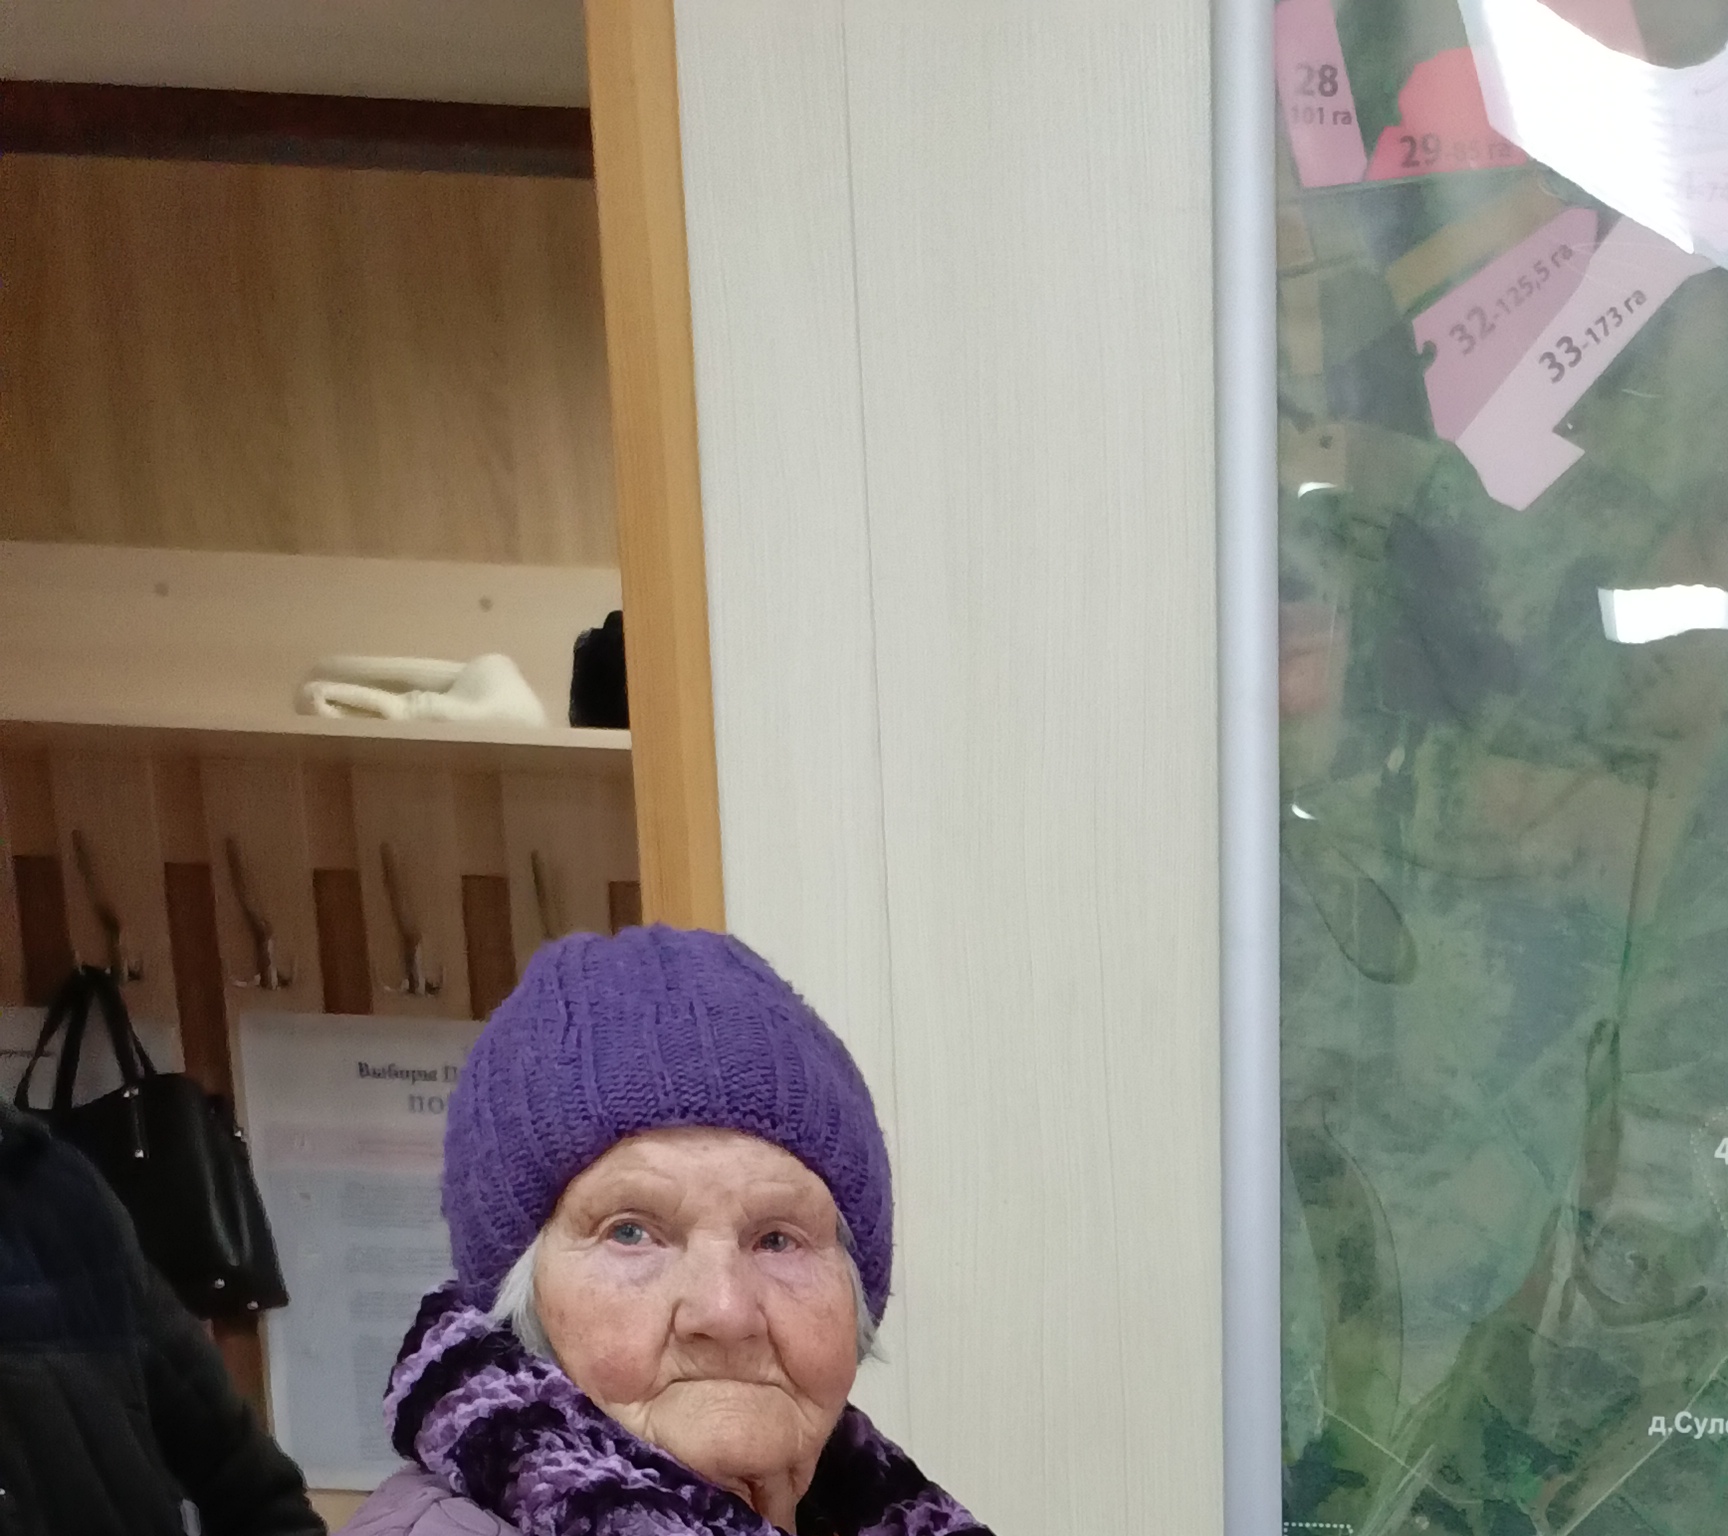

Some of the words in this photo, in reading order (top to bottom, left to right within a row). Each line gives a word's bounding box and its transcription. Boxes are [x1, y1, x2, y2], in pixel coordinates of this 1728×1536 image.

[1297, 64, 1339, 97] 28
[1333, 109, 1352, 125] га
[1550, 244, 1574, 268] га
[1539, 306, 1623, 384] 33-173
[1624, 290, 1647, 314] га
